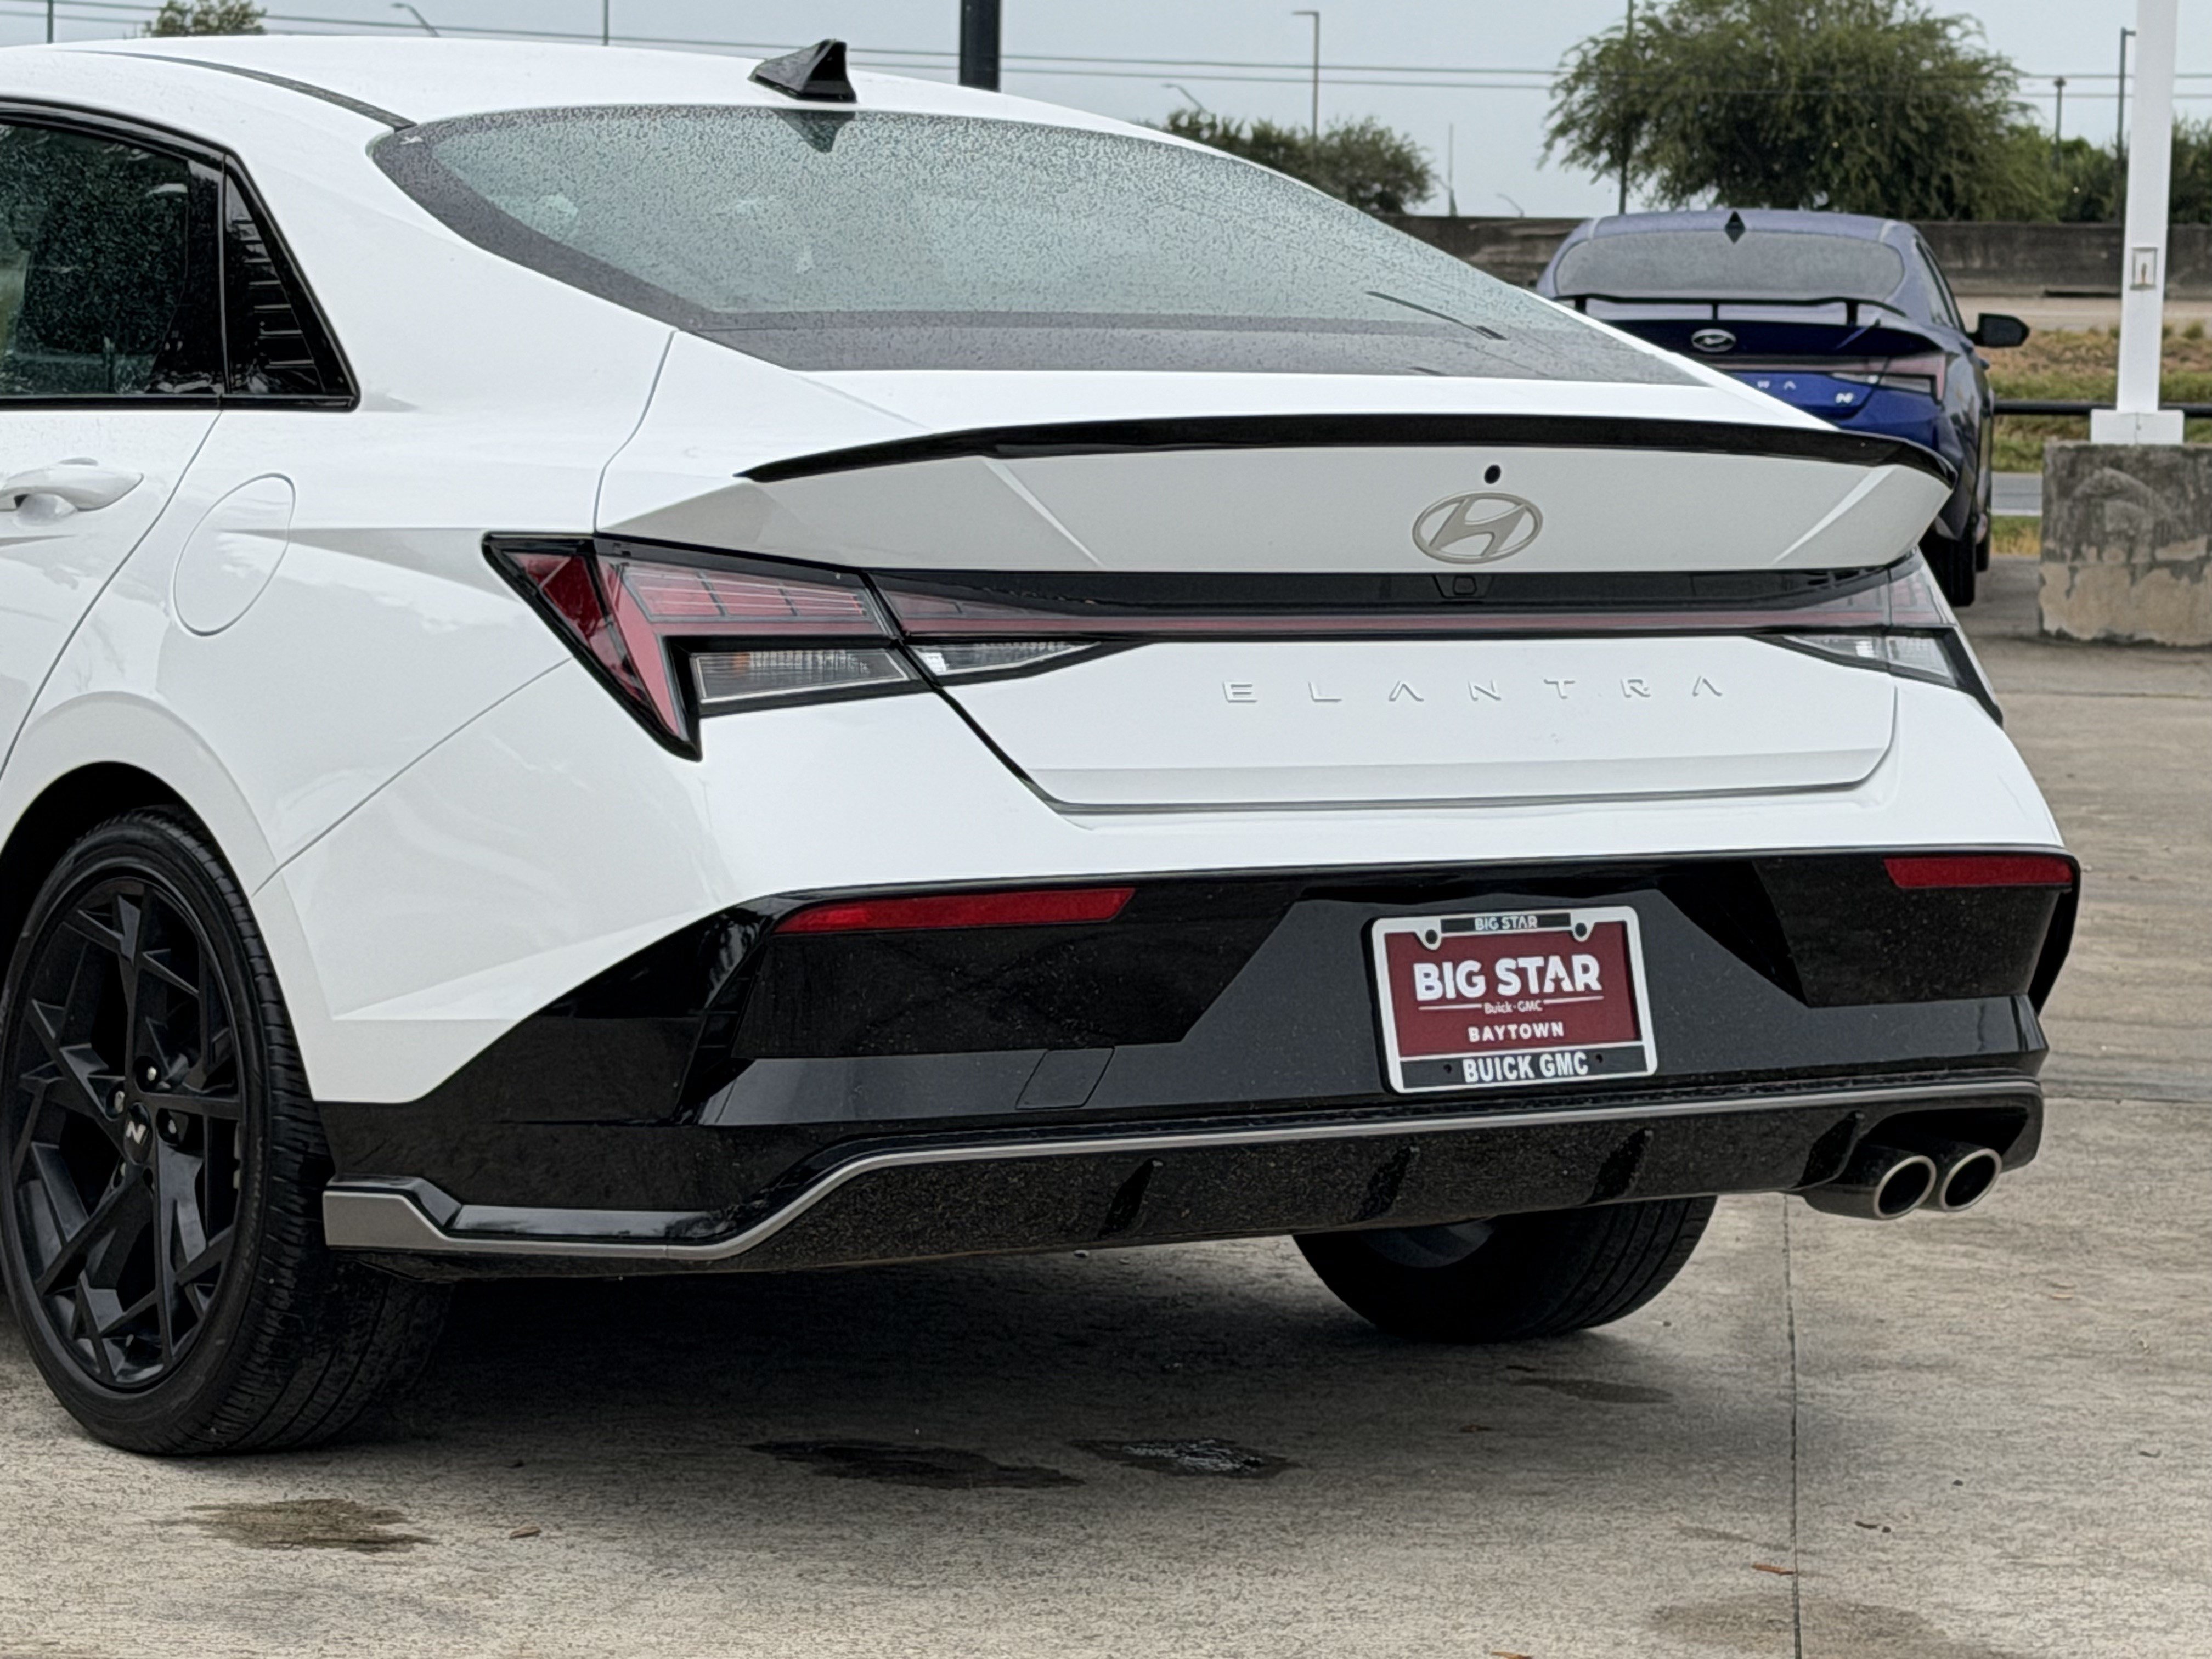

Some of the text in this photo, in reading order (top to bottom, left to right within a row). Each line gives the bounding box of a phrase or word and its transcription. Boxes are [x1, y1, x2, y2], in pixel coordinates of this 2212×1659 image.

[1222, 676, 1723, 703] ELANTRA
[1474, 915, 1538, 931] BIG STAR
[1413, 954, 1602, 1001] BIG STAR
[1467, 1021, 1564, 1042] BAYTOWN
[1462, 1051, 1589, 1083] BUICK GMC
